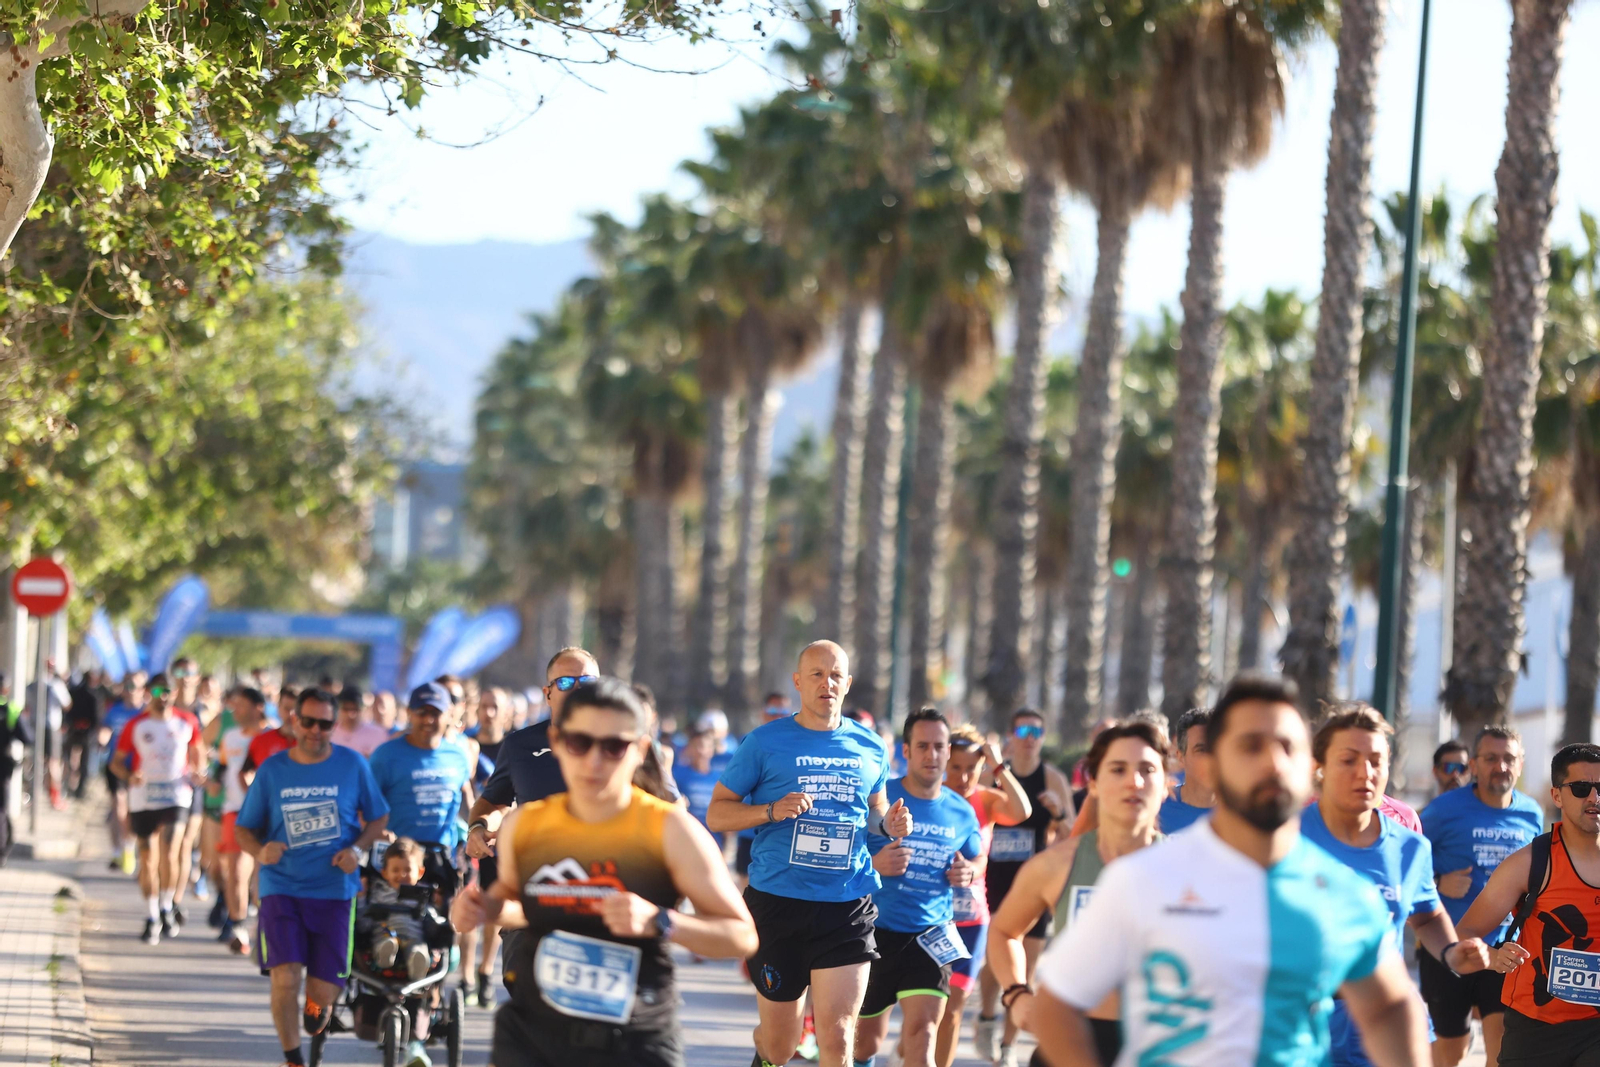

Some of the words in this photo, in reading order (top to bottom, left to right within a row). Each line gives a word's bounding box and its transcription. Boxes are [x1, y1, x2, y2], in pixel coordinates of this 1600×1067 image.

[796, 755, 863, 770] mayoral
[797, 775, 864, 787] RUNNING
[280, 785, 339, 799] mayoral
[805, 784, 856, 795] MAKES
[811, 792, 856, 803] RIENDS
[294, 816, 332, 833] 2073
[913, 822, 956, 840] ayoral
[1472, 827, 1525, 842] mayoral
[819, 839, 831, 853] 5
[1563, 955, 1585, 964] Carrera
[1563, 961, 1589, 969] Solidaria
[549, 962, 620, 992] 1917
[1558, 969, 1600, 988] 201
